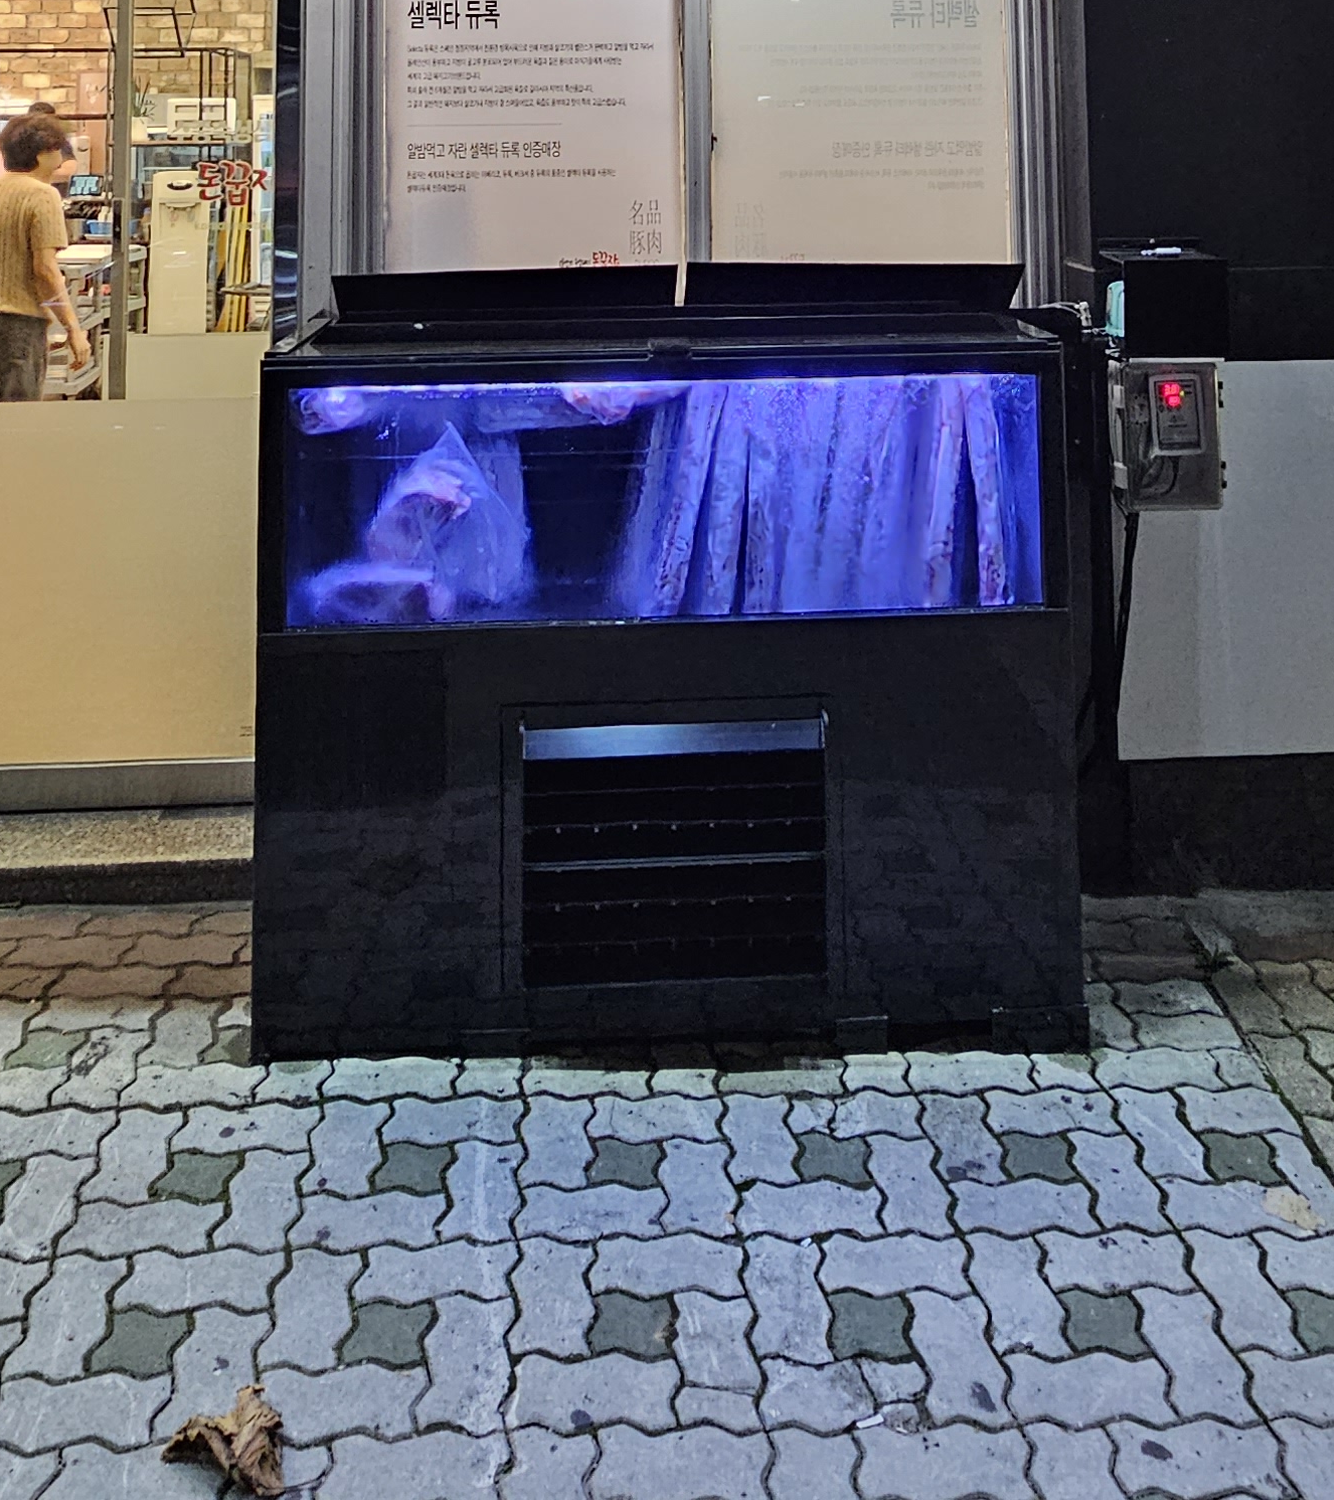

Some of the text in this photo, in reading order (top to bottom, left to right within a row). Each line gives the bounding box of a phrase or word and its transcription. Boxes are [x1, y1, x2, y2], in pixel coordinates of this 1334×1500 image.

[407, 0, 501, 30] 셀렉타 듀록
[407, 142, 445, 160] 알밤먹고
[448, 142, 467, 159] 자란
[501, 141, 520, 158] 듀록
[523, 140, 561, 158] 인증매장
